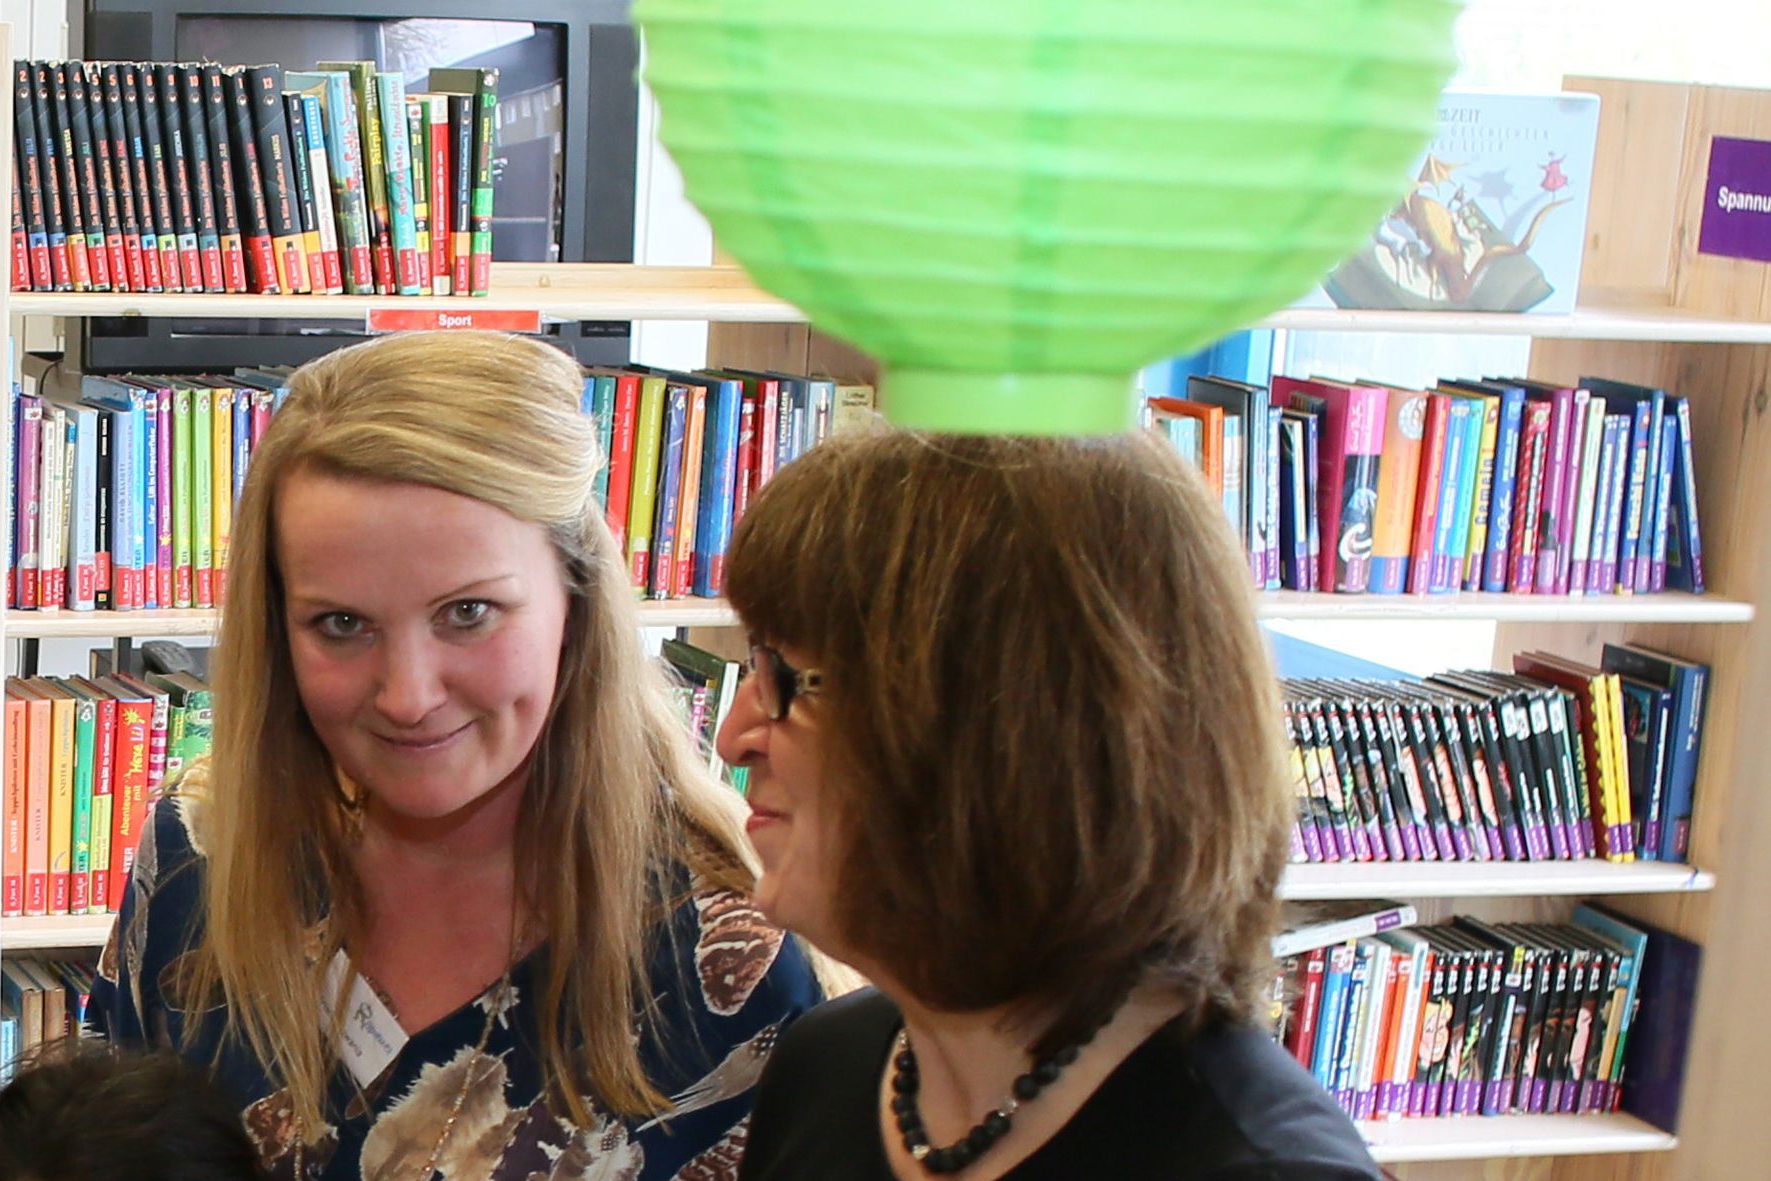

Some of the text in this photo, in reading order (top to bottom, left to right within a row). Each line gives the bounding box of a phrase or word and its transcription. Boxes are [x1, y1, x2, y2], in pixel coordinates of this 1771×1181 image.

[63, 128, 73, 156] VANESSA
[270, 134, 282, 160] MARKUS
[370, 117, 381, 165] Fairplay
[71, 196, 81, 219] Wilden
[141, 197, 151, 220] Wilden
[182, 196, 191, 220] Wilden
[224, 197, 233, 221] Wilden
[280, 198, 290, 222] Wilden
[438, 313, 472, 329] Sport
[129, 743, 143, 774] Hexe
[133, 784, 142, 801] mit
[120, 785, 131, 836] Abenteuer
[10, 820, 18, 853] KNISTER
[34, 807, 42, 841] KNISTER
